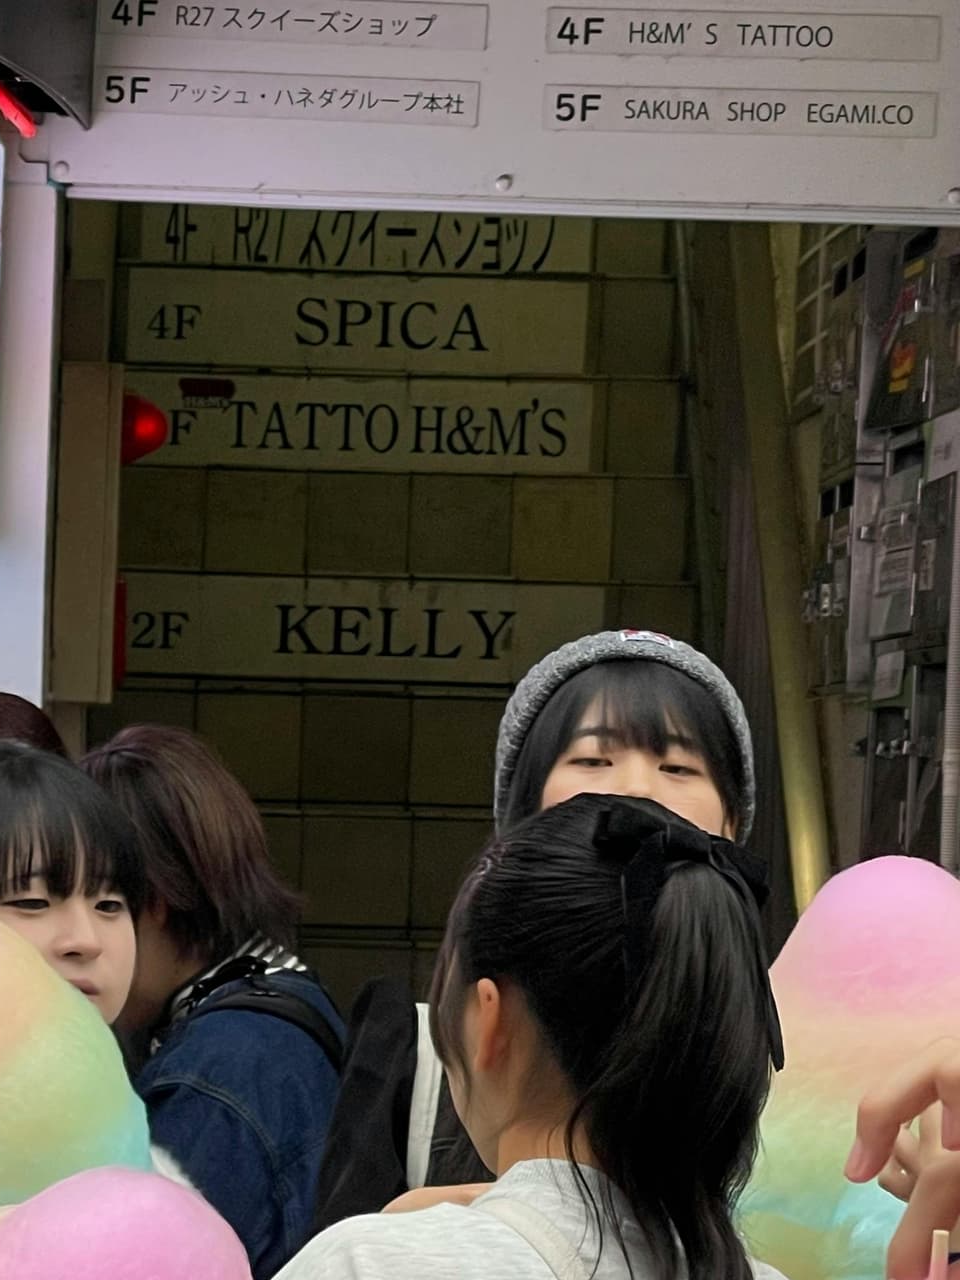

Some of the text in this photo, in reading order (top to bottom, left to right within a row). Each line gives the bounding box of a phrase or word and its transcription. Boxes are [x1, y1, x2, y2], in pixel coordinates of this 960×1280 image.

[111, 0, 438, 37] 4F R27 スクイーズショップ
[557, 17, 604, 45] 4F
[736, 24, 834, 47] TATTOO
[105, 76, 465, 115] 5F アッシュ・ハネダグループ本社
[555, 94, 914, 126] 5F SAKURA SHOP EGAMI.CO
[147, 297, 489, 352] 4F SPICA
[229, 400, 399, 454] TATTO
[130, 603, 517, 660] 2F KELLY
